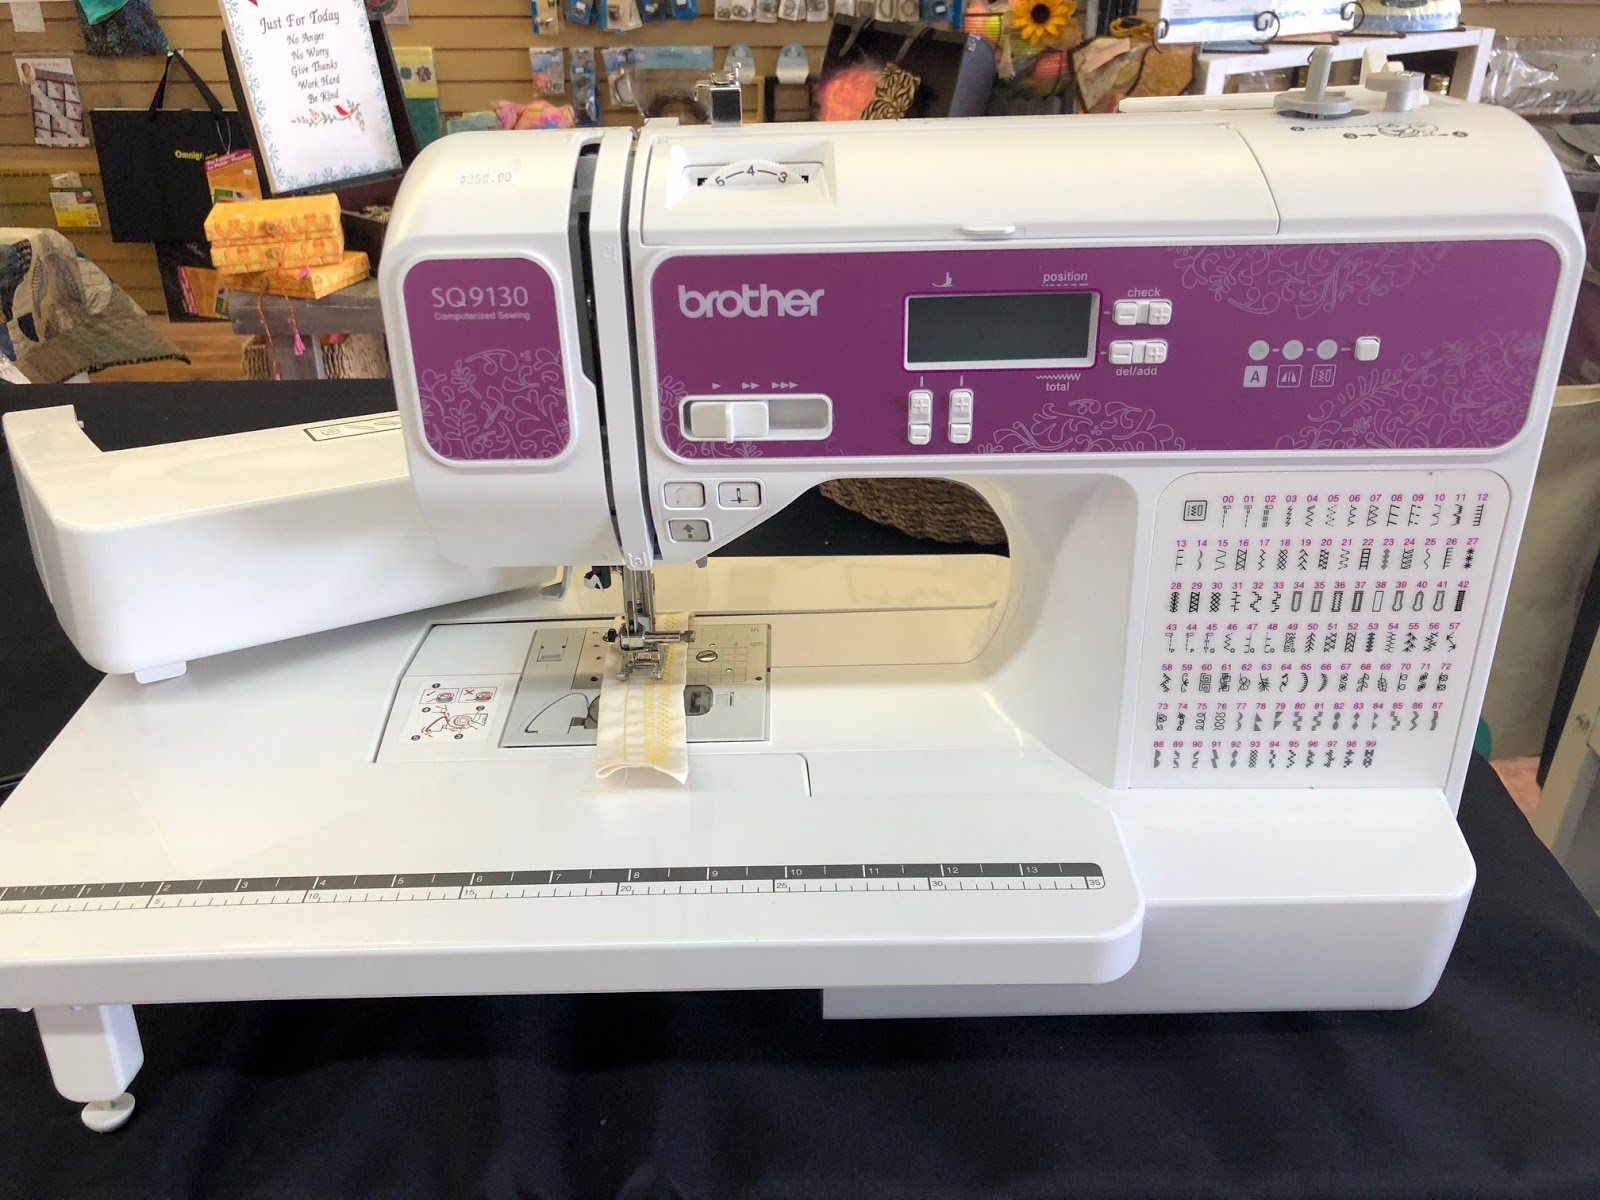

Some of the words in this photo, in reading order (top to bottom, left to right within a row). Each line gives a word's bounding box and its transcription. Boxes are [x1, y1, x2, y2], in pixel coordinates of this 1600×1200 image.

[260, 17, 282, 34] Just
[286, 14, 305, 28] For
[310, 8, 340, 25] Today
[286, 34, 299, 45] No
[302, 32, 324, 44] Anger
[291, 49, 304, 60] No
[306, 47, 329, 58] Worry
[291, 65, 309, 78] Give
[312, 59, 338, 72] Thanks
[298, 78, 320, 90] Work
[320, 74, 340, 86] Hard
[308, 94, 318, 104] Be
[320, 89, 338, 102] Kind
[460, 172, 512, 184] $350.00
[746, 164, 755, 176] 4
[778, 172, 788, 183] 3
[1042, 271, 1088, 284] position
[432, 286, 528, 308] SQ9130
[1128, 287, 1160, 298] check
[678, 284, 824, 318] brother
[434, 312, 496, 322] Computerized
[498, 311, 530, 322] Sewing
[1116, 366, 1158, 376] del/add
[1250, 370, 1260, 383] A
[1046, 382, 1070, 392] total
[1221, 495, 1234, 504] 00
[1243, 495, 1256, 504] 01
[1264, 495, 1277, 504] 02
[1285, 495, 1297, 503] 03
[1307, 494, 1319, 503] 04
[1328, 494, 1340, 503] 05
[1347, 494, 1360, 503] 06
[1368, 494, 1381, 502] 07
[1391, 494, 1404, 502] 08
[1411, 493, 1424, 502] 09
[1433, 493, 1446, 502] 10
[1455, 493, 1465, 502] 11
[1476, 493, 1488, 501] 12
[1177, 539, 1188, 548] 13
[1196, 539, 1209, 547] 14
[1218, 538, 1229, 547] 15
[1238, 538, 1251, 547] 16
[1259, 538, 1270, 547] 17
[1280, 538, 1293, 547] 18
[1300, 538, 1312, 547] 19
[1320, 538, 1332, 547] 20
[1340, 538, 1353, 547] 21
[1361, 538, 1374, 547] 22
[1383, 538, 1395, 546] 23
[1404, 538, 1417, 546] 24
[1425, 538, 1437, 546] 25
[1444, 537, 1457, 546] 26
[1465, 537, 1478, 546] 27
[1170, 581, 1183, 590] 28
[1191, 581, 1203, 590] 29
[1211, 581, 1223, 590] 30
[1232, 581, 1243, 590] 31
[1251, 581, 1264, 590] 32
[1272, 581, 1285, 590] 33
[1292, 581, 1305, 590] 34
[1314, 581, 1326, 589] 35
[1334, 580, 1346, 589] 36
[1354, 580, 1366, 589] 37
[1375, 580, 1388, 589] 38
[1396, 580, 1408, 589] 39
[1416, 580, 1428, 589] 40
[1435, 580, 1448, 589] 41
[1457, 580, 1470, 589] 42
[1167, 624, 1178, 632] 43
[1186, 623, 1198, 632] 44
[1207, 623, 1219, 632] 45
[1226, 623, 1238, 632] 46
[1246, 623, 1258, 632] 47
[1266, 623, 1279, 632] 48
[1287, 623, 1299, 632] 49
[1306, 622, 1319, 631] 50
[1327, 622, 1339, 631] 51
[1347, 622, 1360, 631] 52
[1367, 622, 1380, 631] 53
[1387, 622, 1400, 631] 54
[1408, 622, 1420, 631] 55
[1428, 622, 1440, 630] 56
[1448, 622, 1461, 630] 57
[1161, 663, 1174, 672] 58
[1180, 663, 1193, 672] 59
[1200, 663, 1213, 671] 60
[1219, 663, 1231, 671] 61
[1240, 662, 1252, 671] 62
[1260, 662, 1272, 671] 63
[1280, 662, 1293, 671] 64
[1299, 662, 1312, 671] 65
[1320, 662, 1332, 671] 66
[1339, 662, 1352, 671] 67
[1360, 662, 1373, 671] 68
[1379, 662, 1391, 671] 69
[1399, 662, 1412, 671] 70
[1420, 662, 1432, 671] 71
[1440, 662, 1453, 671] 72
[1158, 702, 1168, 711] 73
[1178, 702, 1188, 711] 74
[1197, 702, 1209, 711] 75
[1217, 702, 1228, 711] 76
[1237, 702, 1248, 711] 77
[1255, 702, 1268, 711] 78
[1275, 702, 1287, 711] 79
[1294, 702, 1306, 710] 80
[1313, 702, 1325, 710] 81
[1332, 702, 1345, 710] 82
[1352, 702, 1364, 710] 83
[1372, 702, 1384, 710] 84
[1391, 701, 1404, 710] 85
[1411, 701, 1423, 710] 86
[1431, 701, 1443, 710] 87
[1152, 740, 1165, 748] 88
[1172, 740, 1184, 748] 89
[1191, 740, 1203, 748] 90
[1211, 740, 1221, 748] 91
[1230, 740, 1242, 748] 92
[1249, 740, 1262, 748] 93
[1268, 740, 1281, 748] 94
[1287, 740, 1299, 748] 95
[1307, 740, 1319, 748] 96
[1326, 740, 1338, 748] 97
[1345, 740, 1358, 748] 98
[1364, 740, 1377, 748] 99
[163, 884, 172, 892] 2
[241, 881, 249, 889] 3
[319, 879, 326, 887] 4
